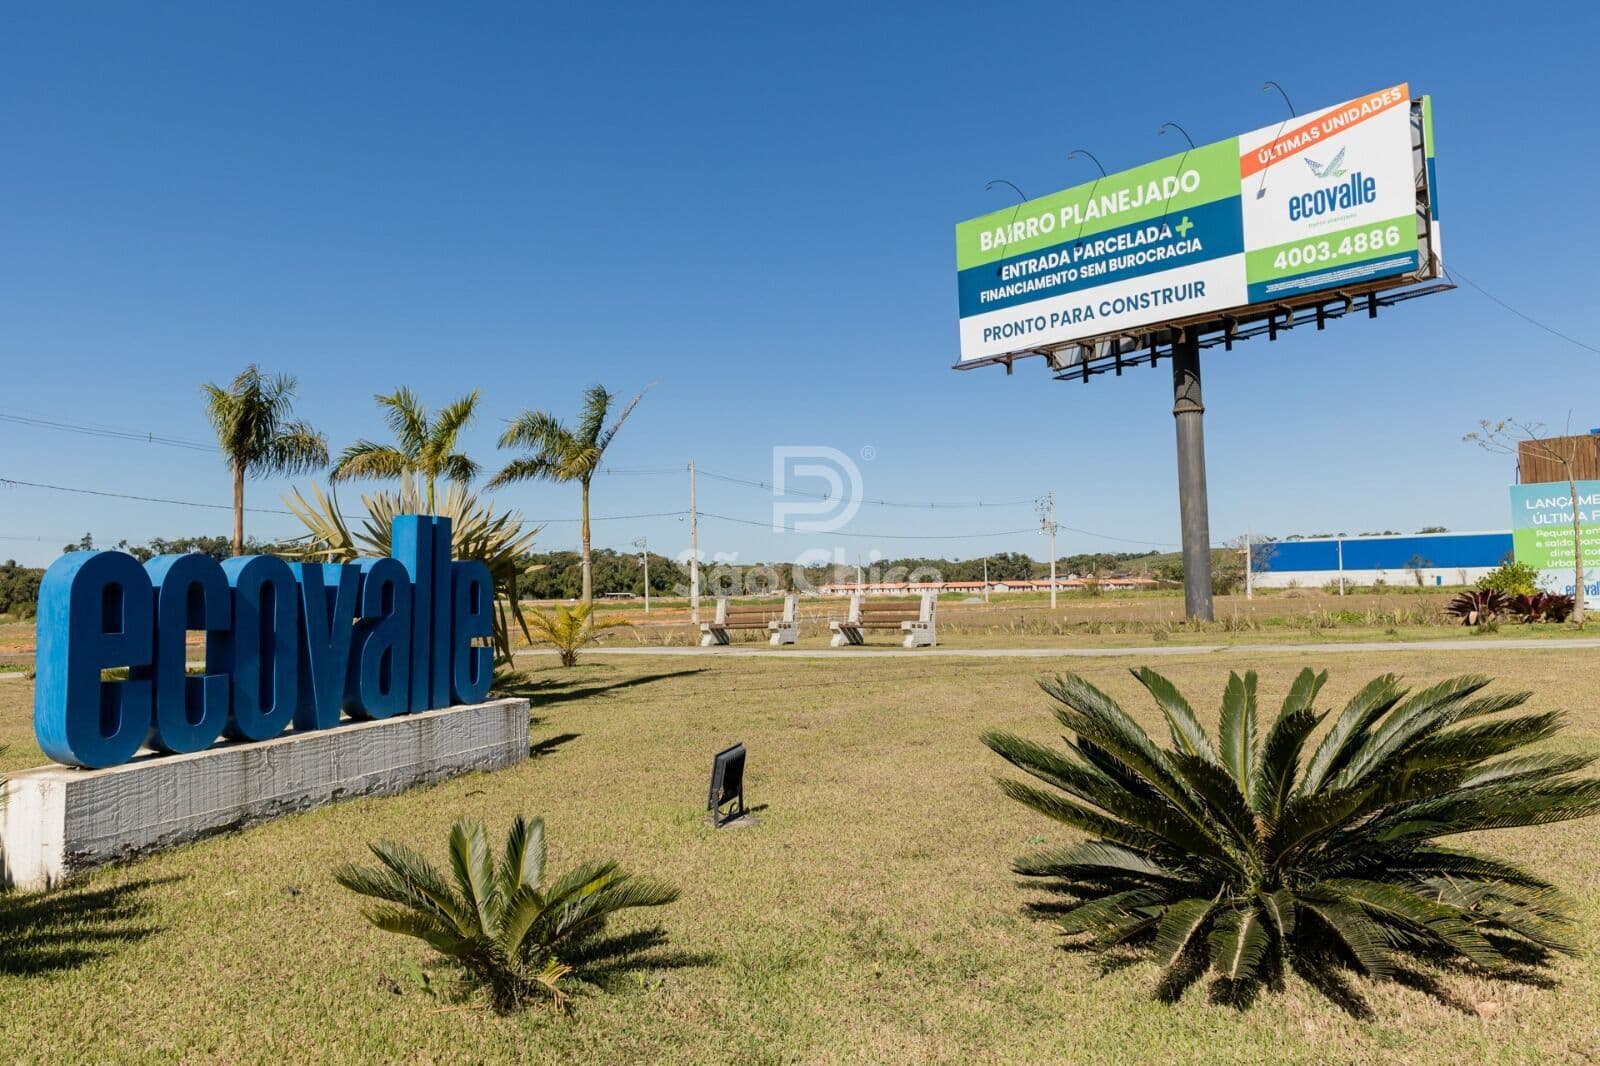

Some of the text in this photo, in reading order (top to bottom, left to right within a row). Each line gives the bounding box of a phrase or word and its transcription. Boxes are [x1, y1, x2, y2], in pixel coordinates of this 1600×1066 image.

[1257, 87, 1402, 165] ÚLTIMAS UNIDADES
[980, 170, 1201, 252] BAIRRO PLANEJADO
[1288, 172, 1377, 222] ecovalle
[980, 238, 1203, 304] FINANCIAMENTO SEM BUROCRACIA
[1001, 252, 1071, 281] ENTRADA
[1073, 224, 1173, 261] PARCELADA
[1273, 225, 1400, 270] 4003.4886
[983, 280, 1206, 343] PRONTO PARA CONSTRUIR
[1550, 548, 1580, 558] diret
[34, 514, 495, 770] ecovalle
